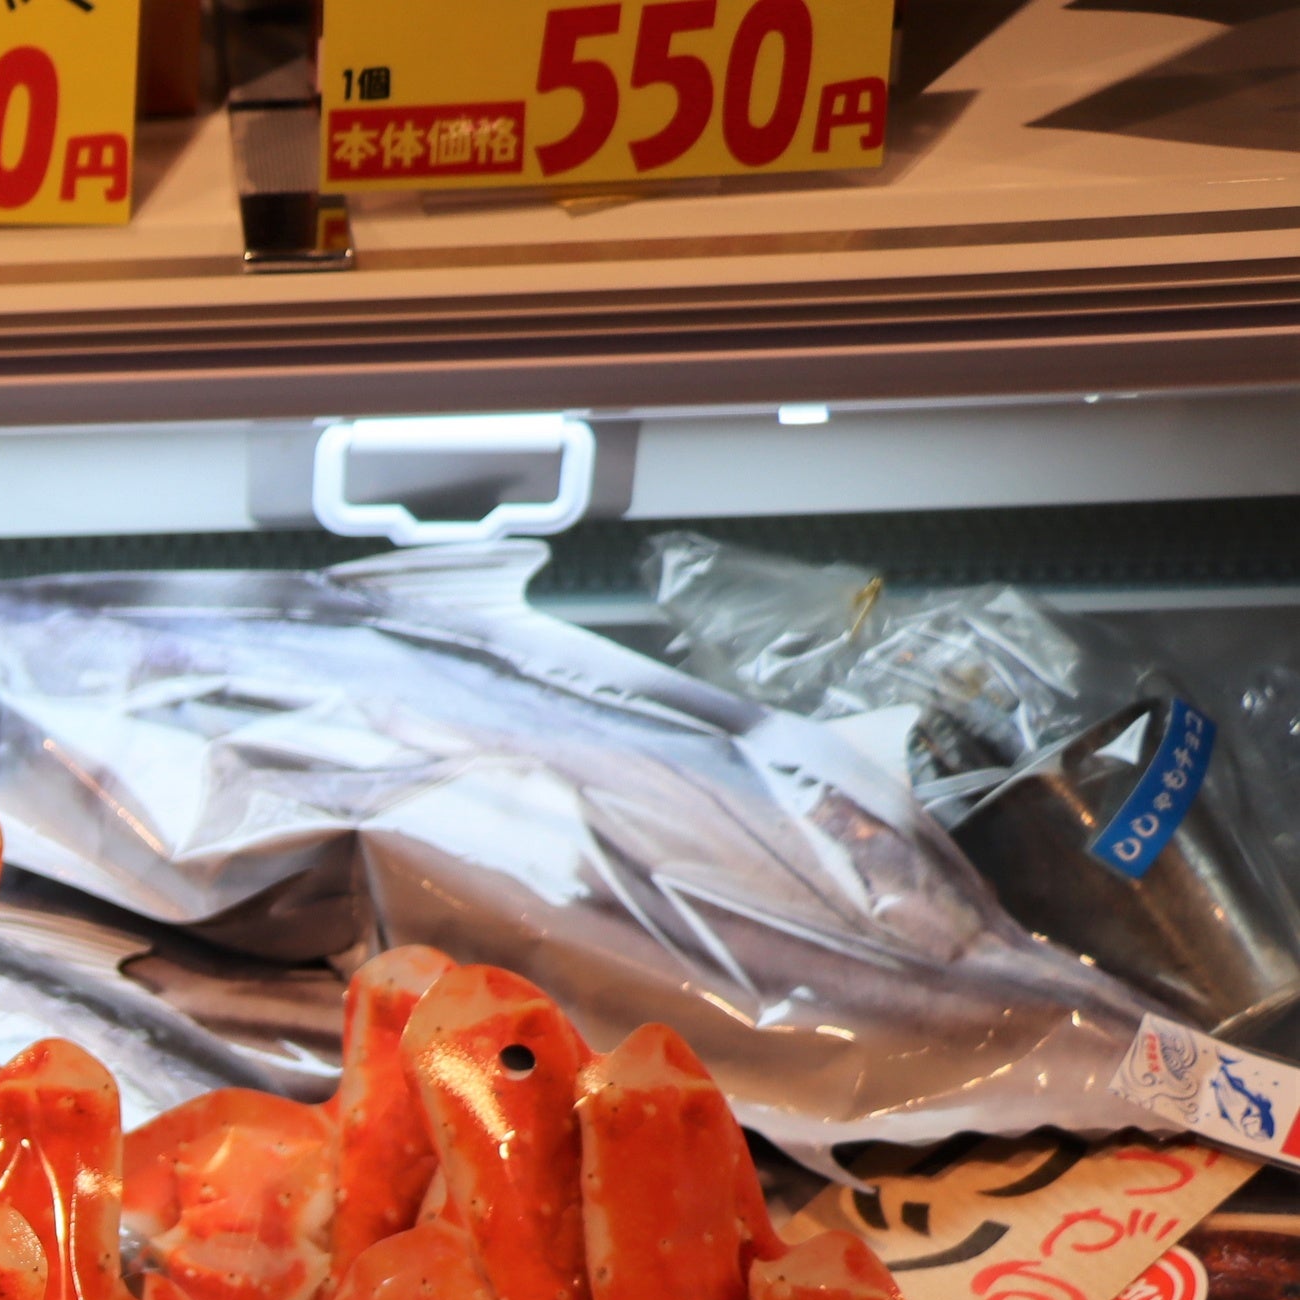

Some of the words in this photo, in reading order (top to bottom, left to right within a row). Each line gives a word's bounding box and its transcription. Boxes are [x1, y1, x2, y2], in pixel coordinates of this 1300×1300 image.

[342, 67, 391, 101] 1個
[332, 118, 518, 170] 本体価格
